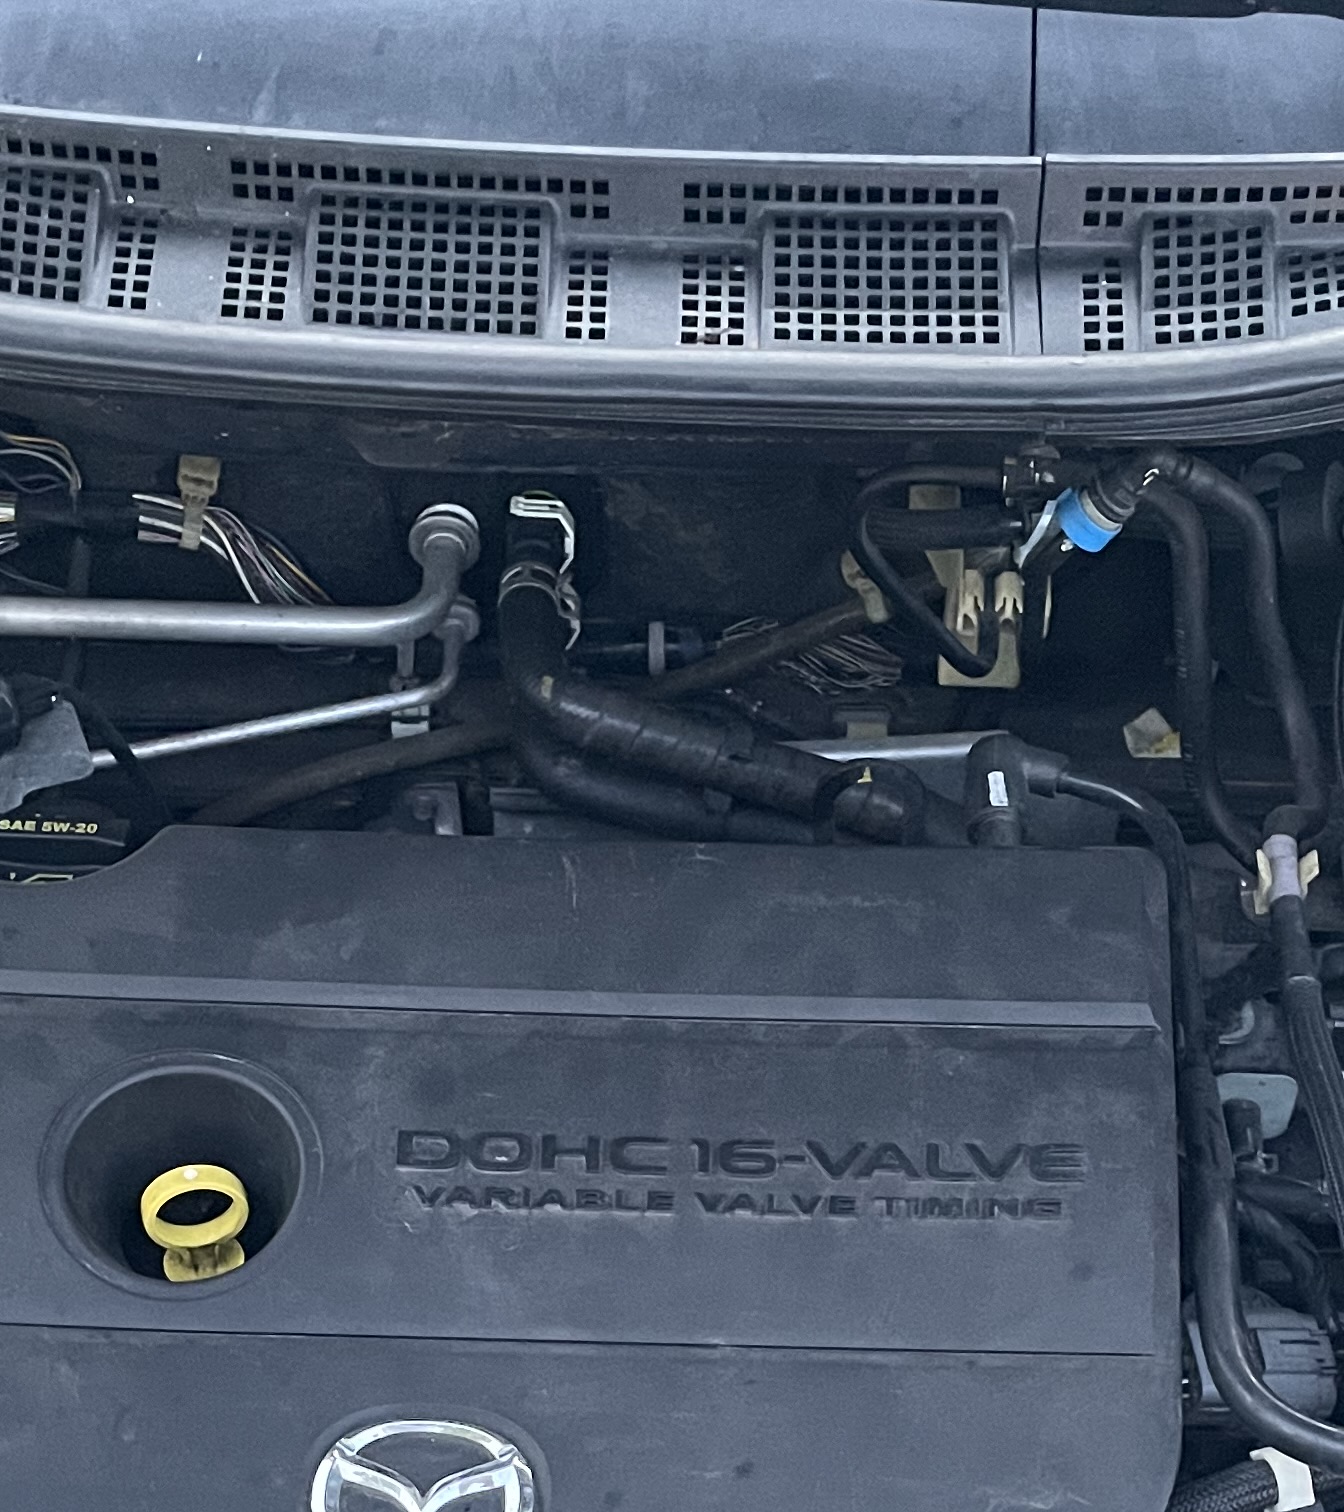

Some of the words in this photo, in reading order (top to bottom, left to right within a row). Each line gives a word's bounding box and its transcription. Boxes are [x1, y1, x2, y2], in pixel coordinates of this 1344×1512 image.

[0, 819, 36, 831] SAE
[41, 821, 98, 834] 5W-20
[396, 1129, 670, 1177] DOHC
[690, 1138, 1086, 1183] 16-VALVE
[408, 1186, 675, 1214] VARIABLE
[694, 1190, 857, 1218] VALVE
[873, 1195, 1063, 1219] TIMING
